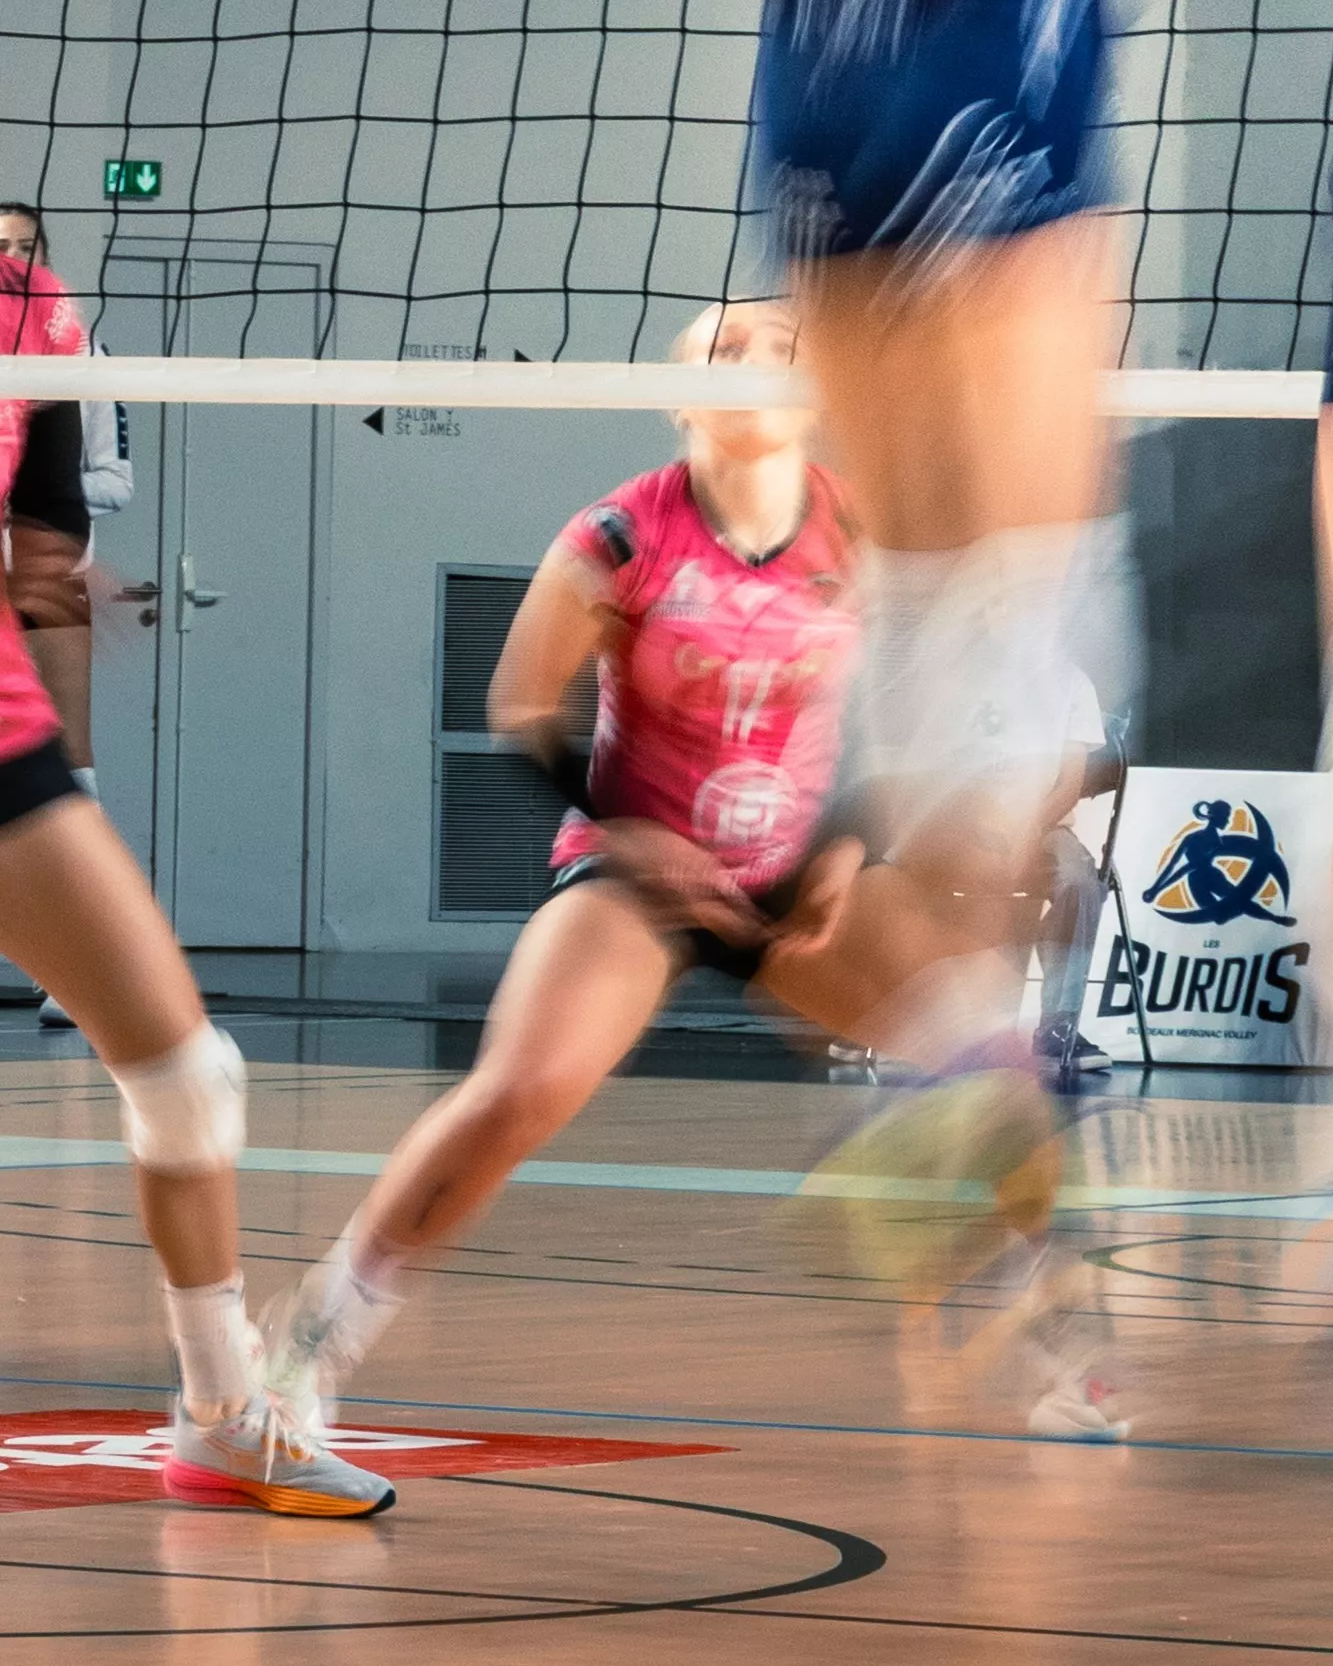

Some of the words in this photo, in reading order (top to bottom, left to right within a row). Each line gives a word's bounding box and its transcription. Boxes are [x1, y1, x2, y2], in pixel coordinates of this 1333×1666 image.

[397, 408, 437, 422] SALON
[420, 424, 461, 436] JAMES
[1203, 940, 1220, 949] LES
[1097, 934, 1310, 1024] BURDIS
